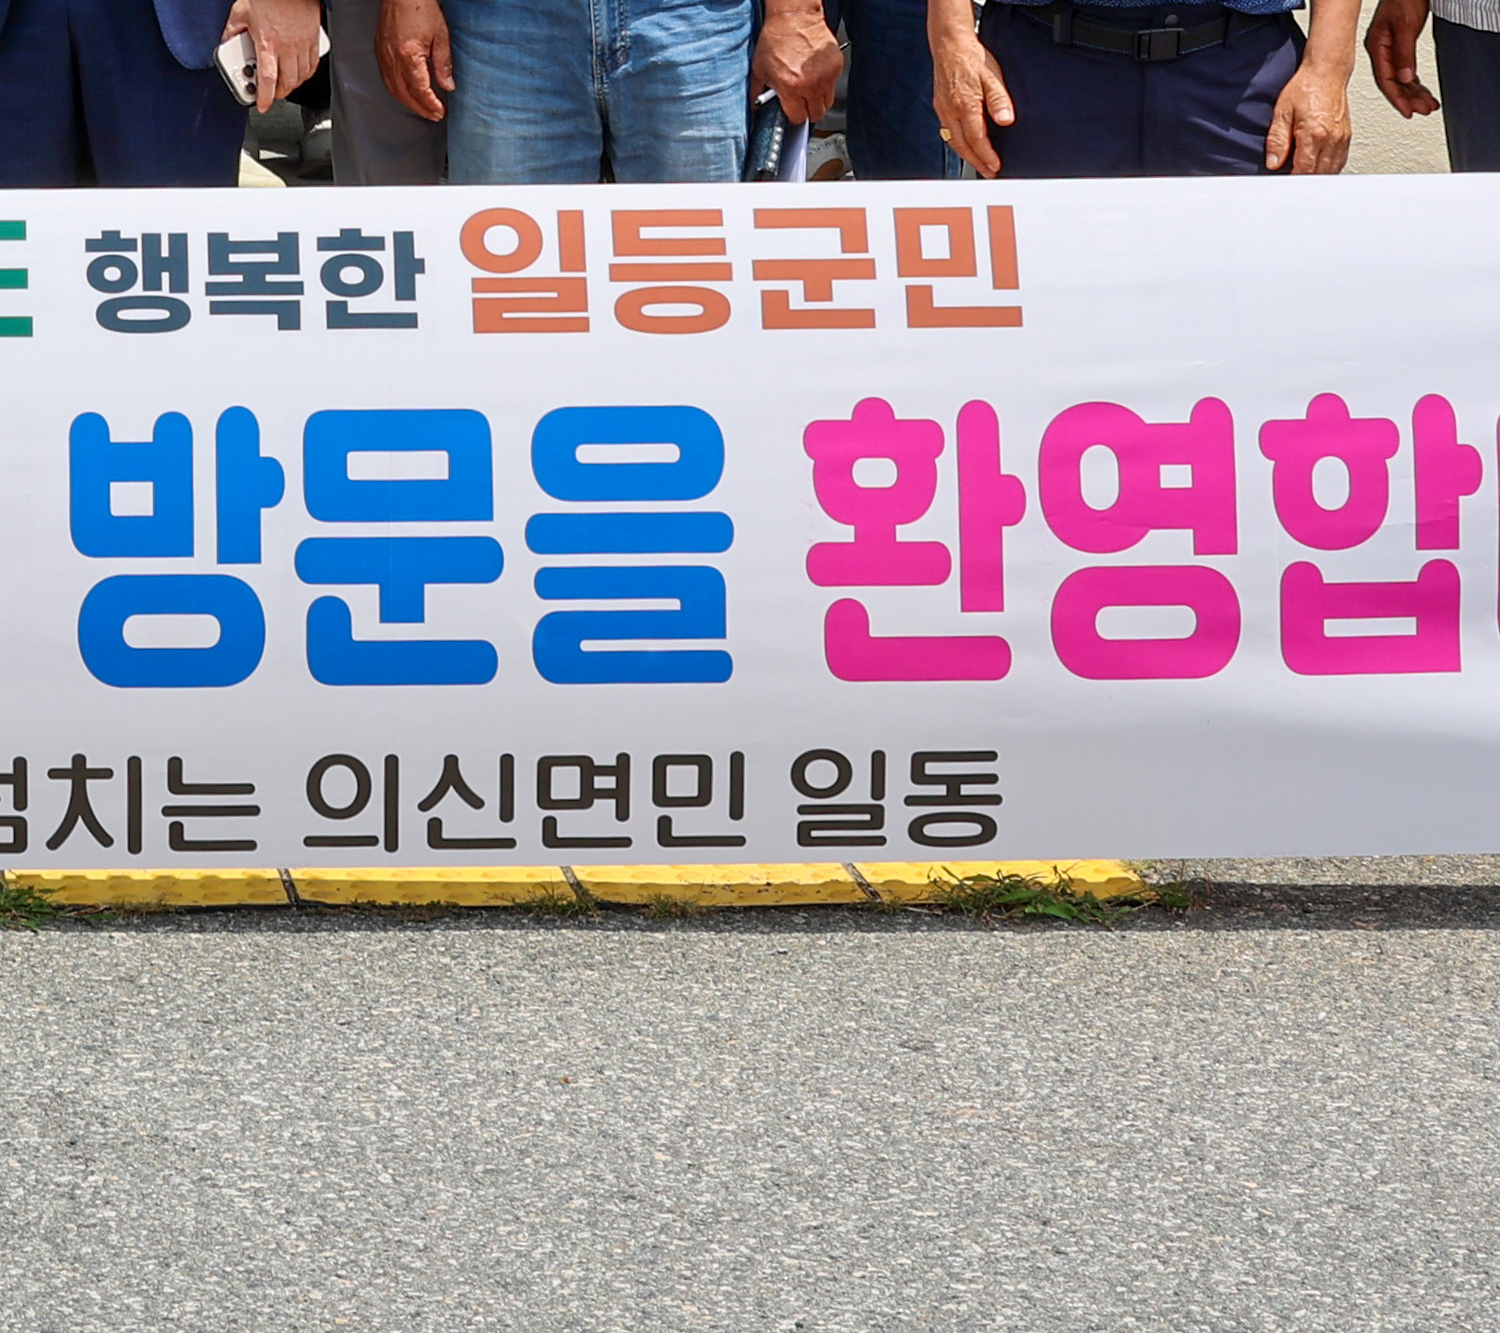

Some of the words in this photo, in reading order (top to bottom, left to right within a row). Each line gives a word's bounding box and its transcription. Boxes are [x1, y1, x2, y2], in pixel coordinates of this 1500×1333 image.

[86, 229, 424, 332] 행복한
[462, 206, 1022, 333] 일등군민
[70, 406, 734, 688] 방문을
[304, 751, 746, 852] 의신면민
[791, 749, 1002, 847] 일동
